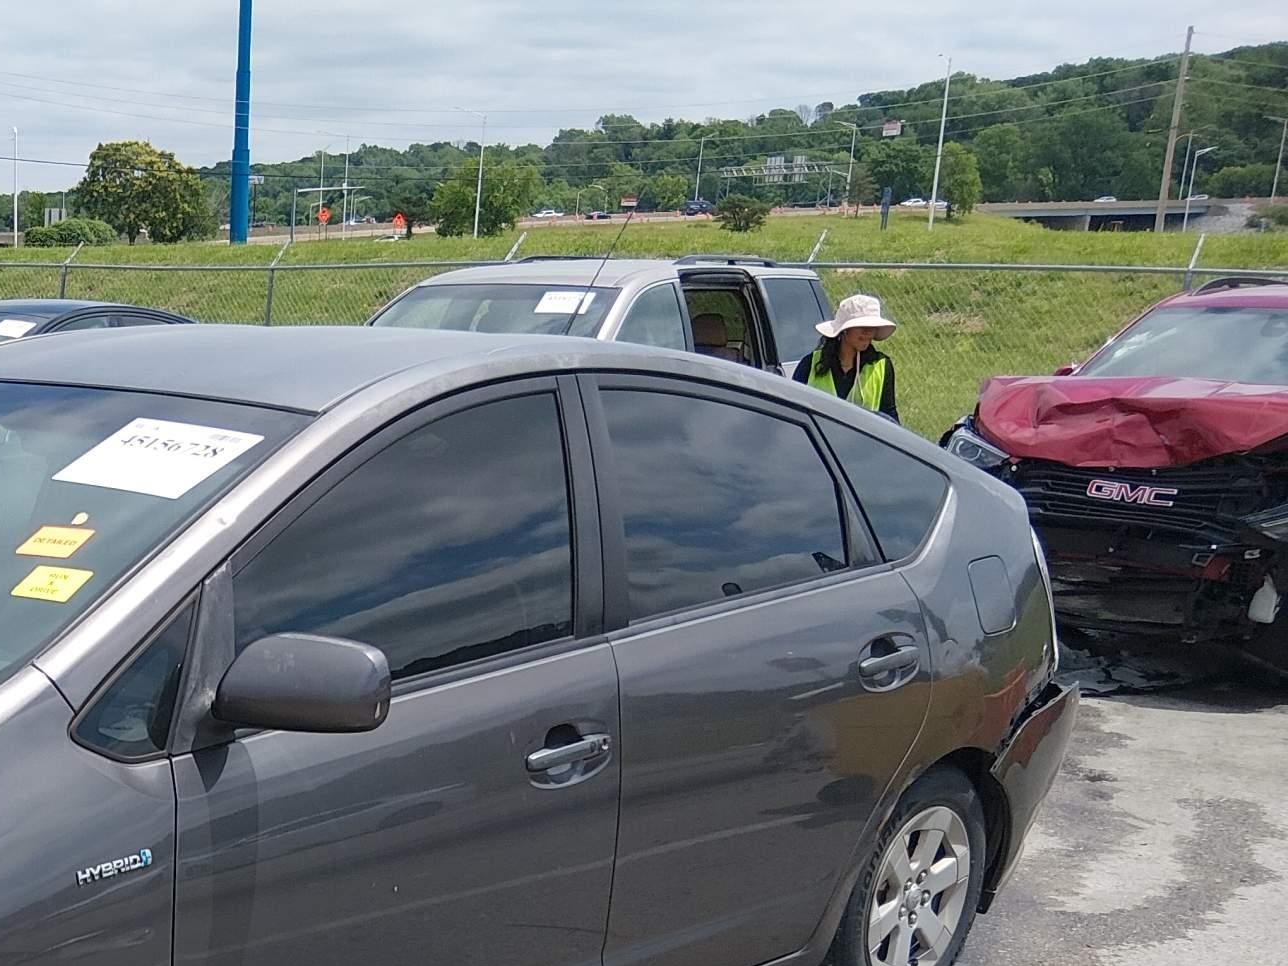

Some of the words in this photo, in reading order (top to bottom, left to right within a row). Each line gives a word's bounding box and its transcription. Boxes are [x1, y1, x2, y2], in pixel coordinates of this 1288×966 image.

[120, 434, 225, 458] 45156728
[1086, 479, 1178, 507] GMC
[76, 854, 143, 886] HYBRID
